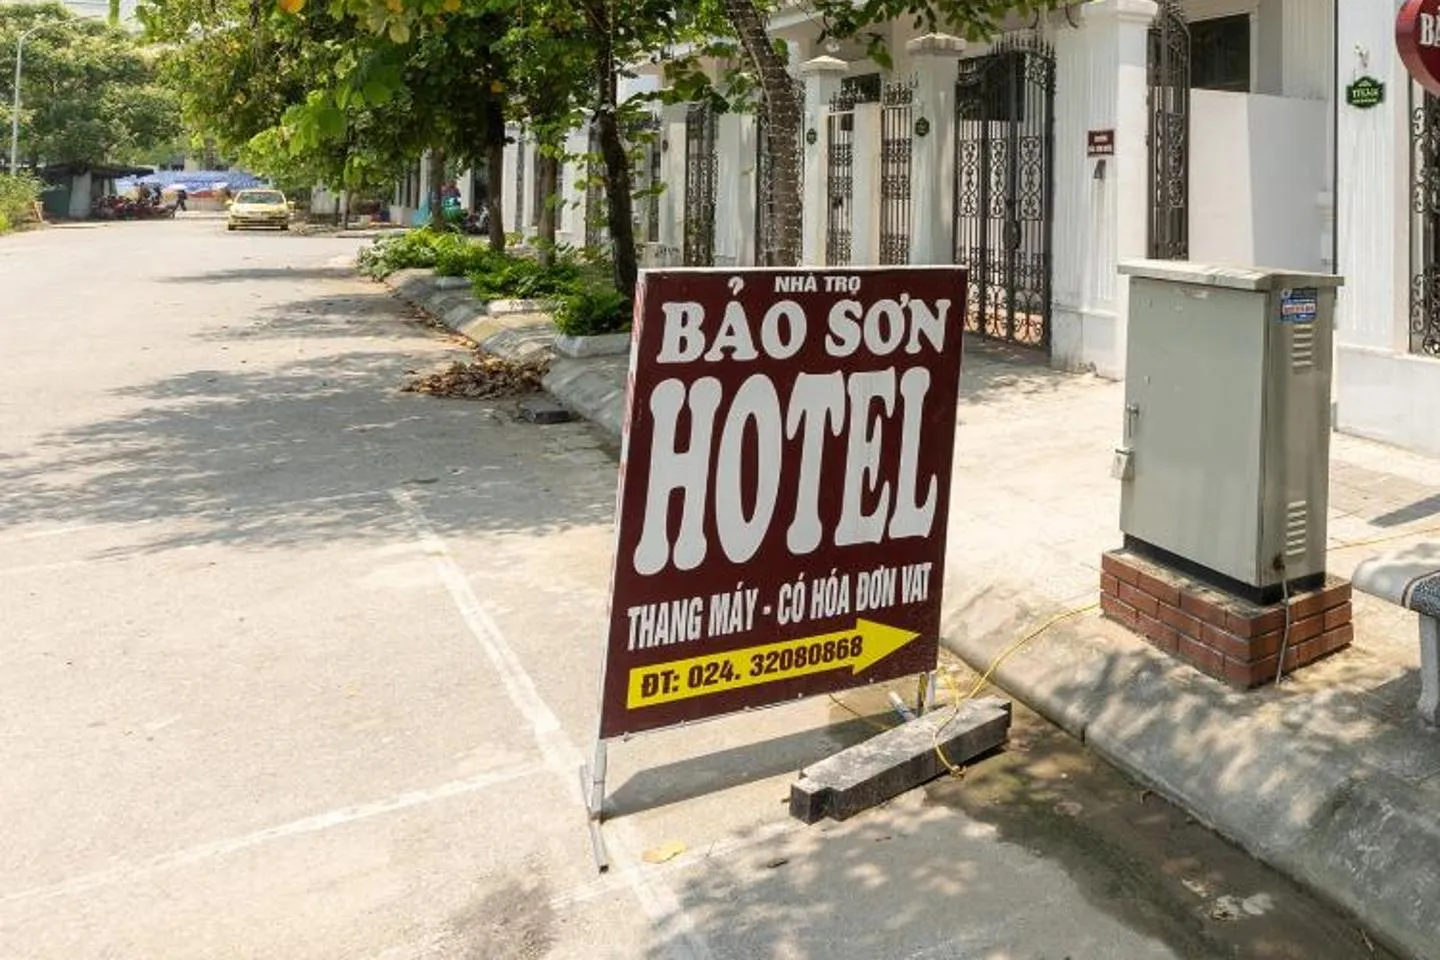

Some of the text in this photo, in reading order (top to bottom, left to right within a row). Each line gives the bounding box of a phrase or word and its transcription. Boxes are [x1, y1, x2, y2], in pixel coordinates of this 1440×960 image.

[656, 276, 952, 364] BẢO SƠN
[774, 271, 861, 296] NHÀ TRỌ
[633, 366, 938, 576] HOTEL
[627, 596, 704, 651] THANG
[708, 581, 760, 637] MÁY
[777, 571, 806, 626] CÓ
[809, 567, 851, 620] HÓA
[855, 565, 898, 611] ĐƠN
[901, 562, 933, 605] VAT
[640, 670, 681, 699] ĐT:
[749, 635, 864, 678] 32080868
